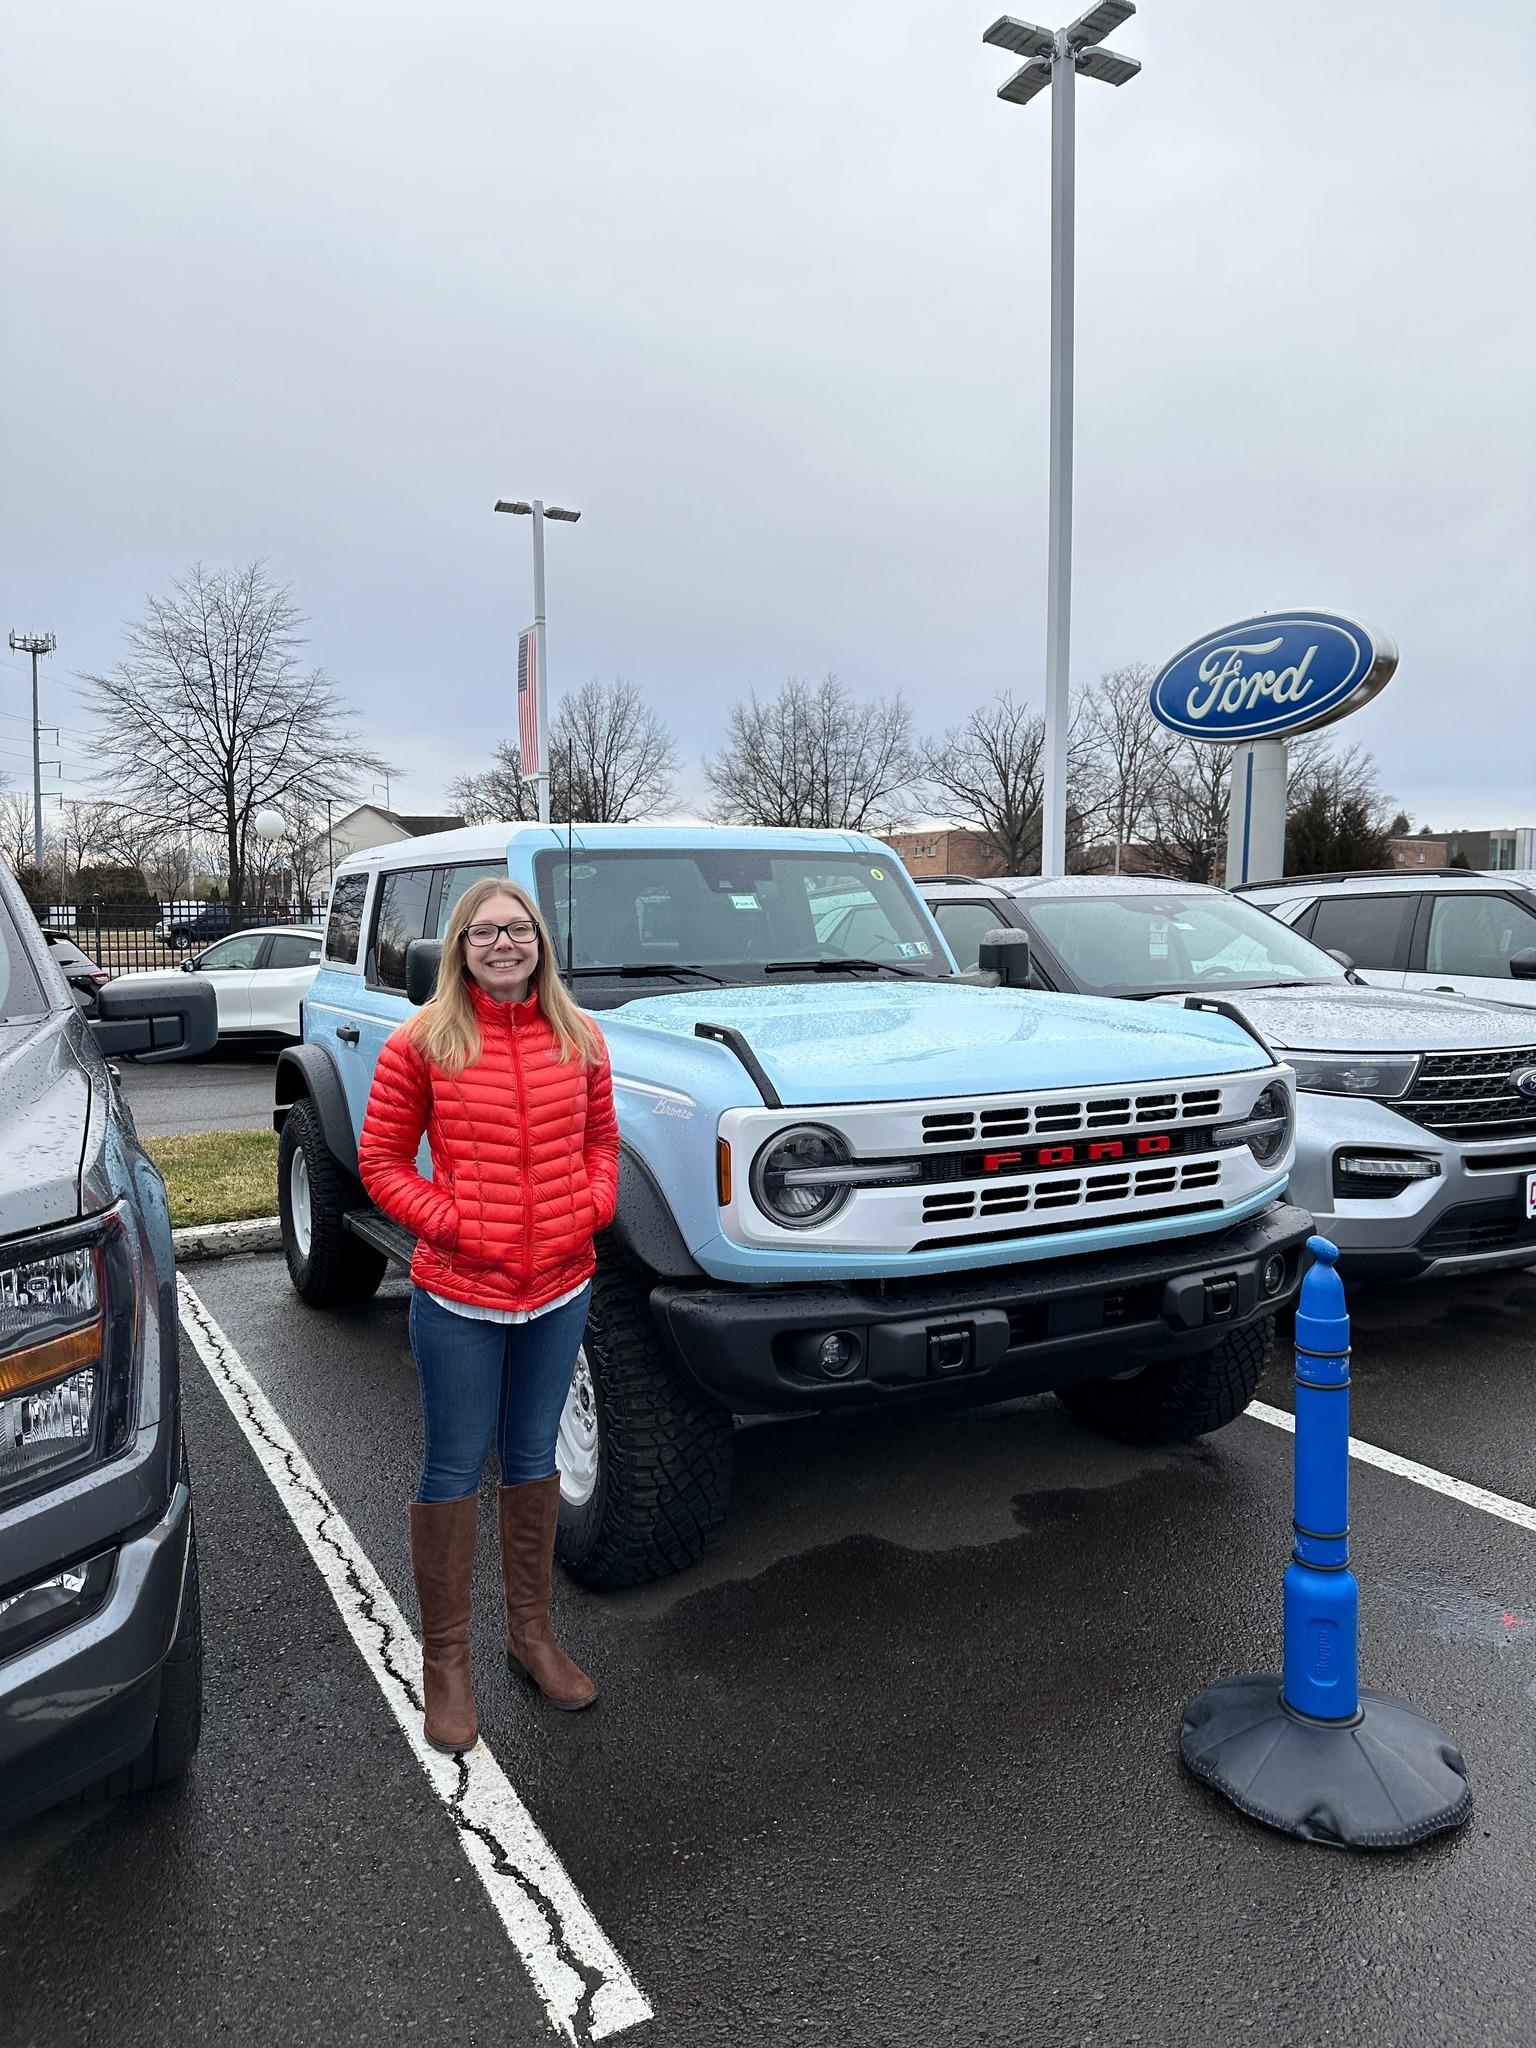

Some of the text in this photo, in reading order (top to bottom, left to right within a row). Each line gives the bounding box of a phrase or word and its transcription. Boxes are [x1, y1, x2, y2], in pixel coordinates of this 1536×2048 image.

[1187, 637, 1318, 719] Ford
[652, 1096, 694, 1120] Bronco
[984, 1136, 1171, 1172] FORD
